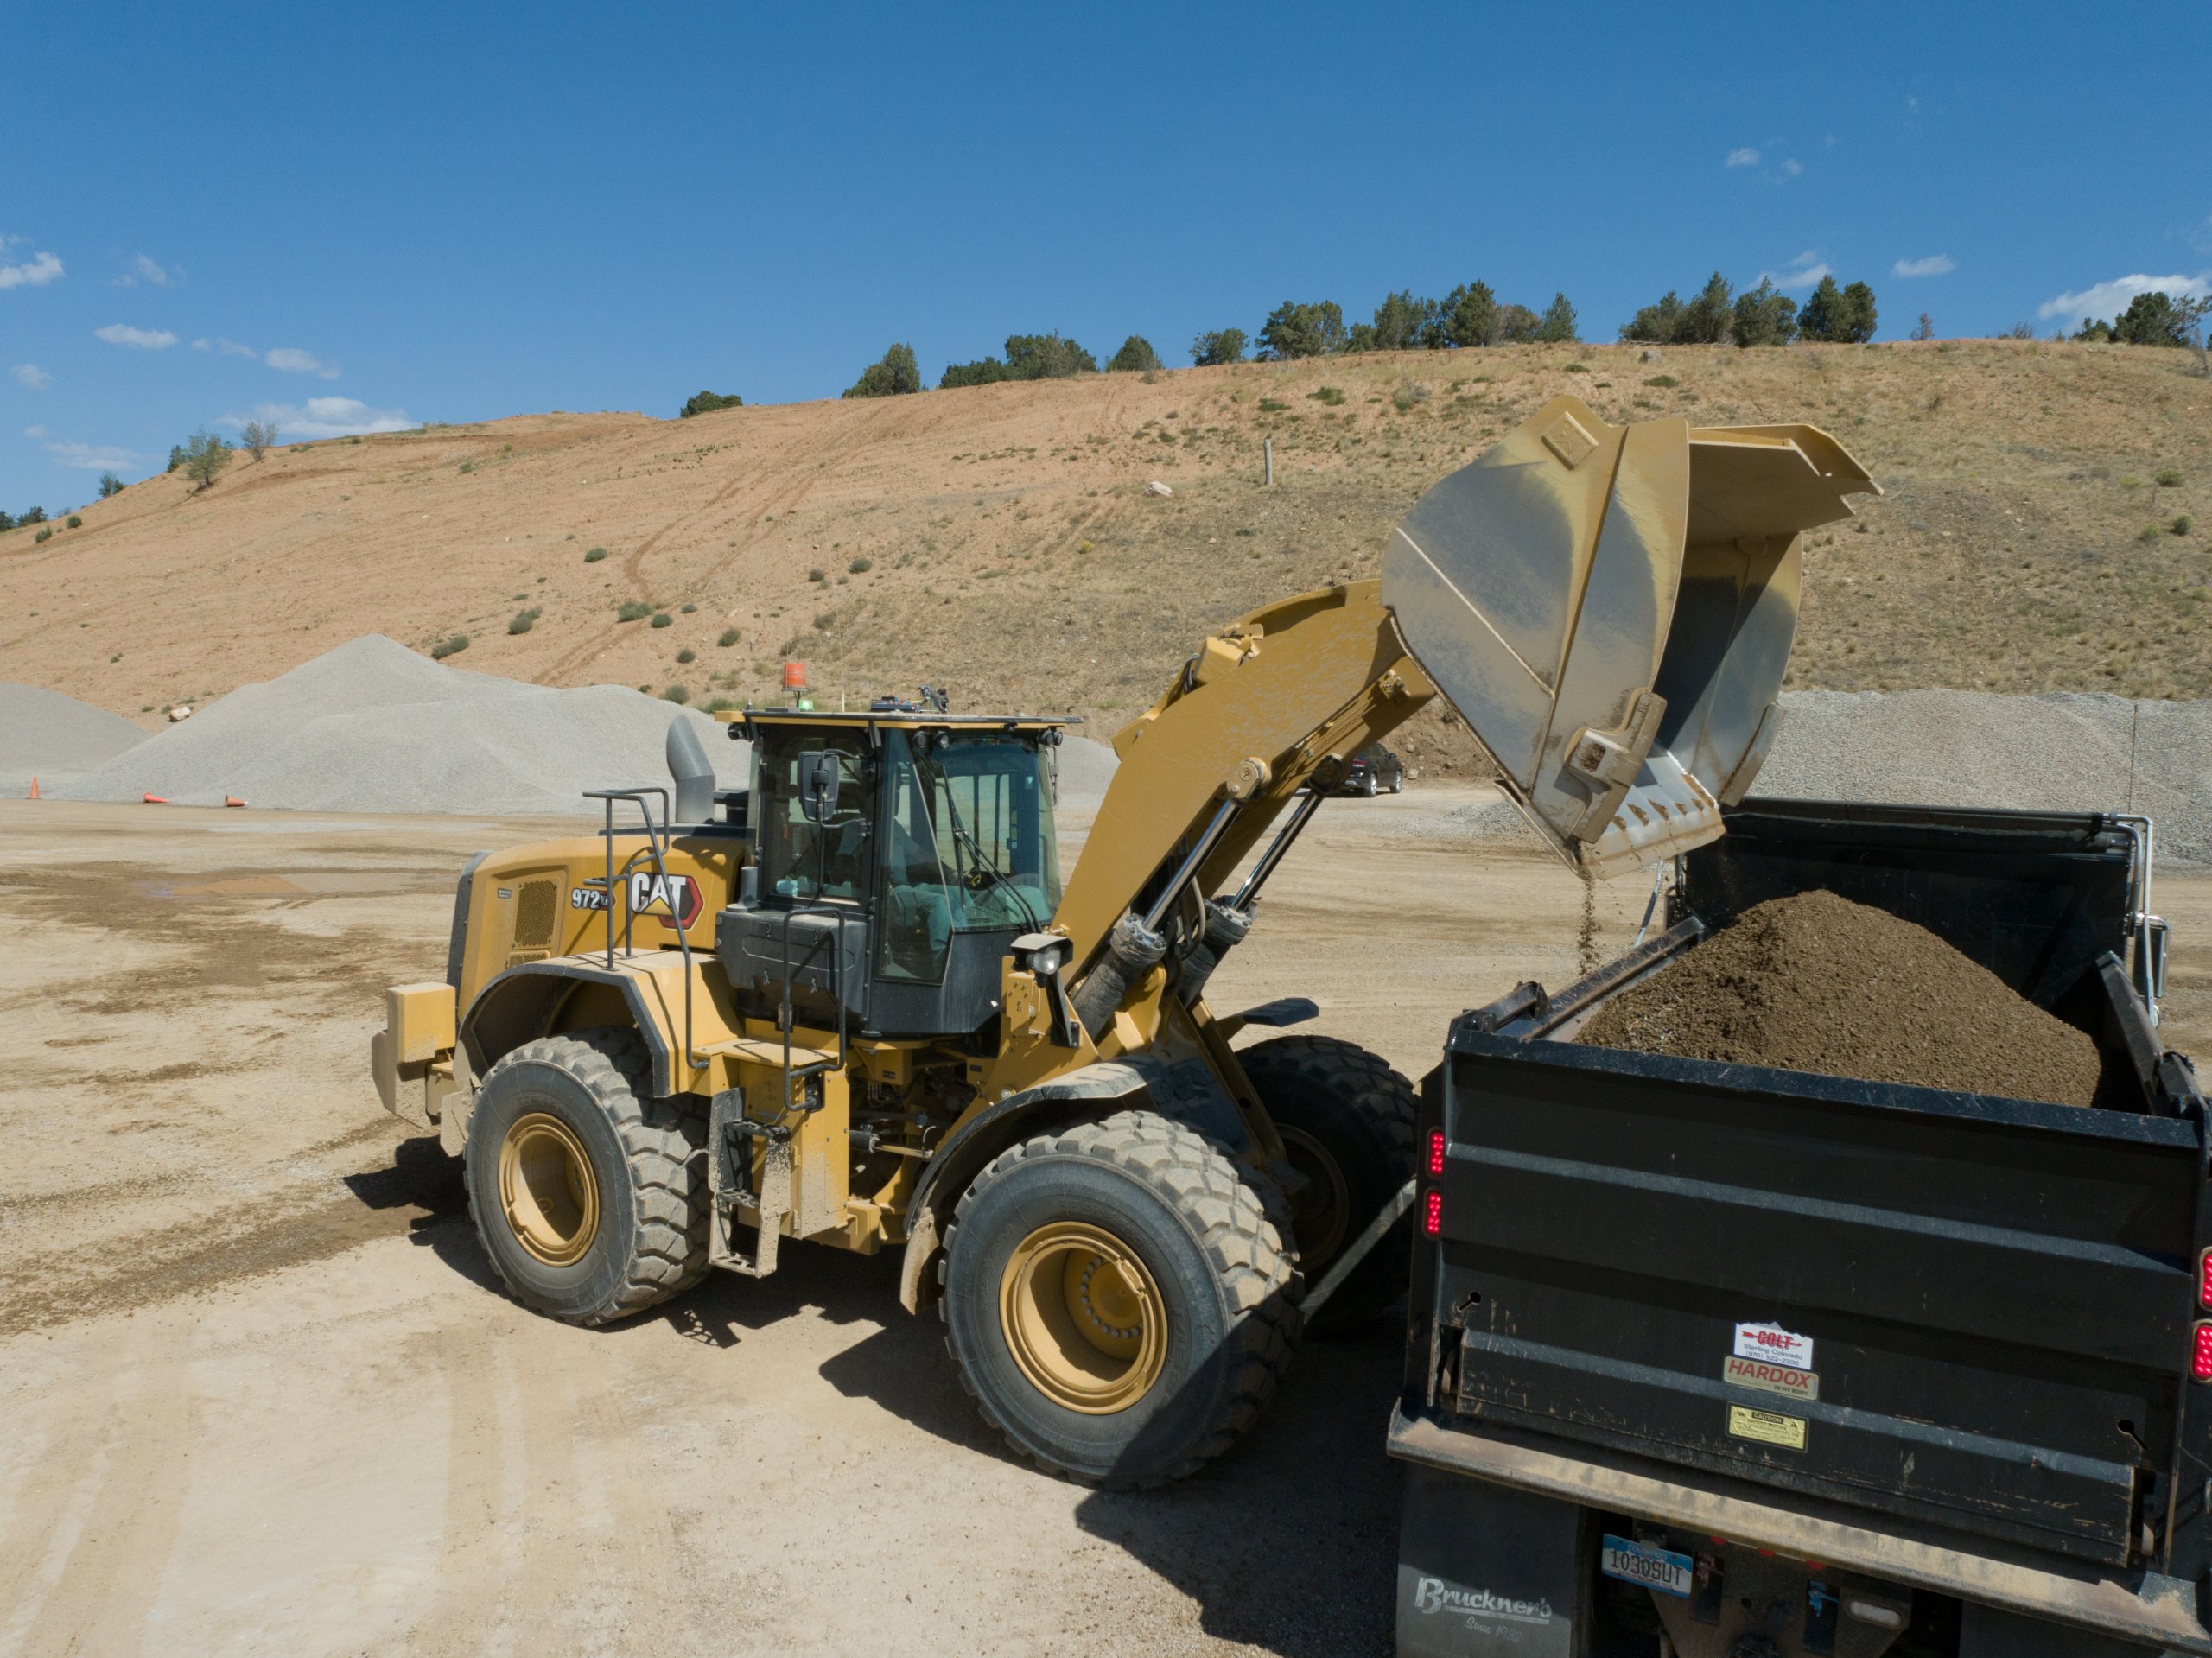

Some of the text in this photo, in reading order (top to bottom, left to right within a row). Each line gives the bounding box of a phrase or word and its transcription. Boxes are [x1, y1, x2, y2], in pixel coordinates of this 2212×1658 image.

[631, 873, 687, 915] CAT
[1757, 1331, 1794, 1350] COLT
[1744, 1344, 1802, 1360] Sterling Colorado
[1745, 1350, 1799, 1366] (970) 522-2206
[1728, 1359, 1812, 1388] HARDOX
[1791, 1388, 1808, 1396] BODY
[1753, 1413, 1783, 1424] CAUTION
[1414, 1577, 1553, 1618] Bruckner's
